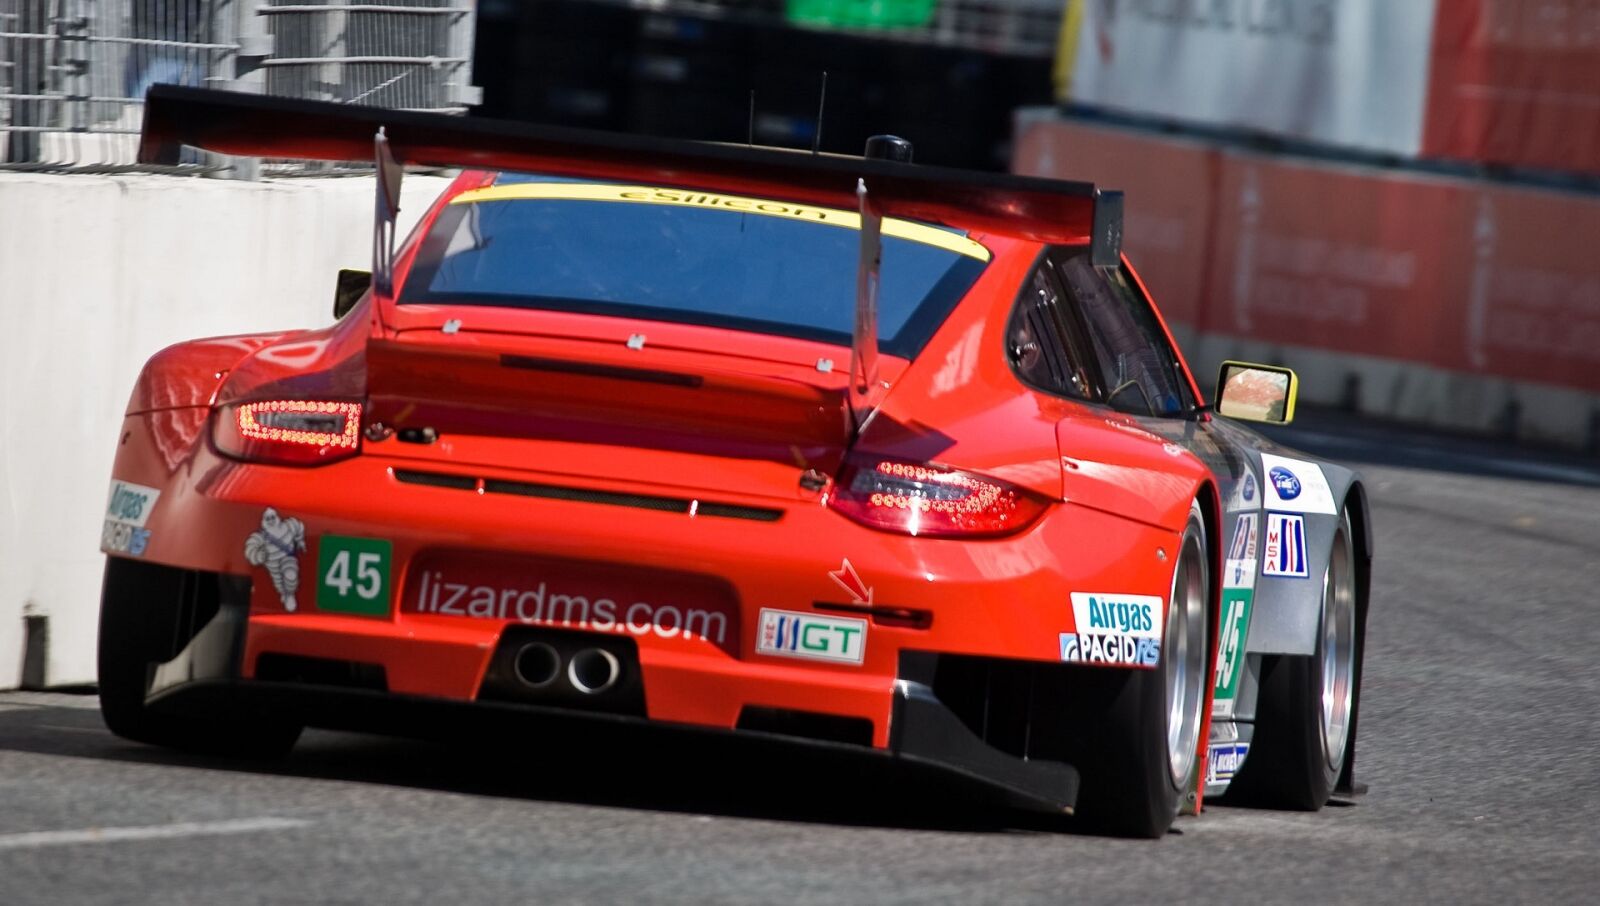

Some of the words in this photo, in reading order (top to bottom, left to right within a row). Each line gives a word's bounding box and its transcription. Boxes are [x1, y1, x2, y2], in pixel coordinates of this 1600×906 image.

[325, 550, 381, 599] 45
[416, 570, 727, 643] lizardms.com
[1088, 597, 1152, 632] Airgas
[802, 623, 860, 654] GT
[1079, 633, 1136, 664] PAGID
[1215, 600, 1245, 689] 45
